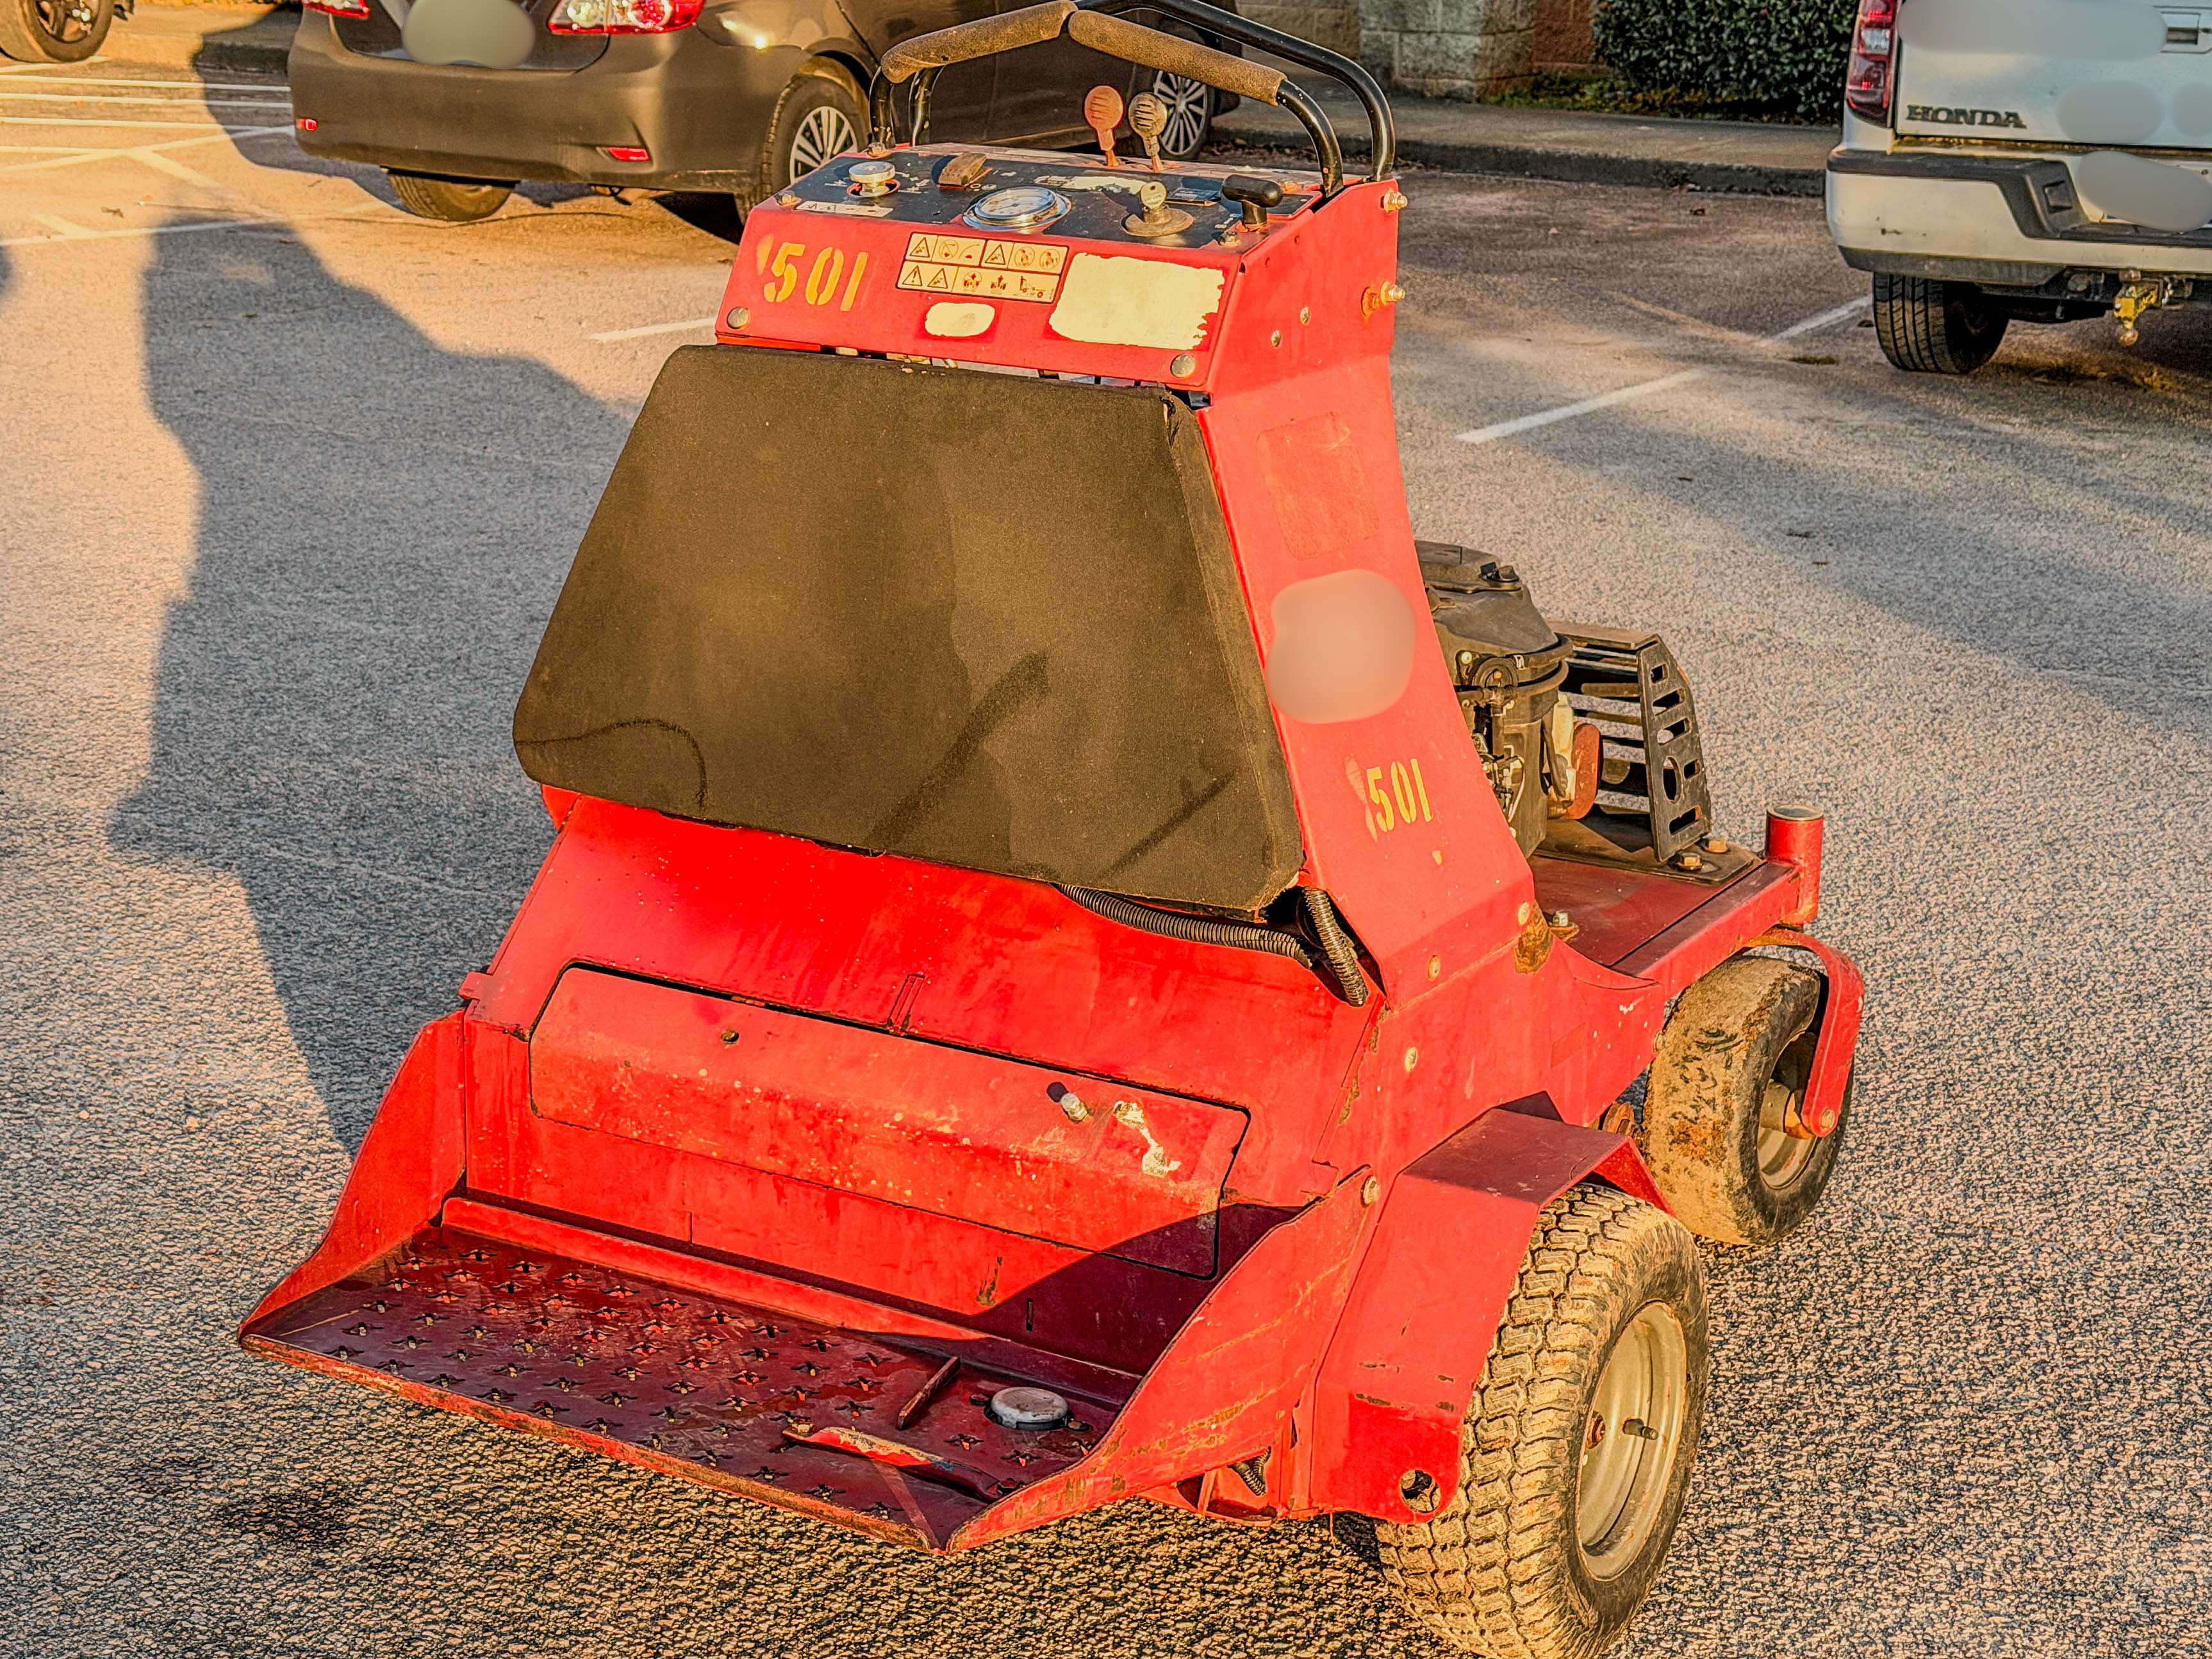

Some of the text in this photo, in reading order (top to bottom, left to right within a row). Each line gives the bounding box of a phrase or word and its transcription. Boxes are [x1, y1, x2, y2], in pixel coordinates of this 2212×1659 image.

[1906, 104, 2027, 129] HONDA
[763, 242, 869, 311] 501
[1366, 758, 1432, 832] 501
